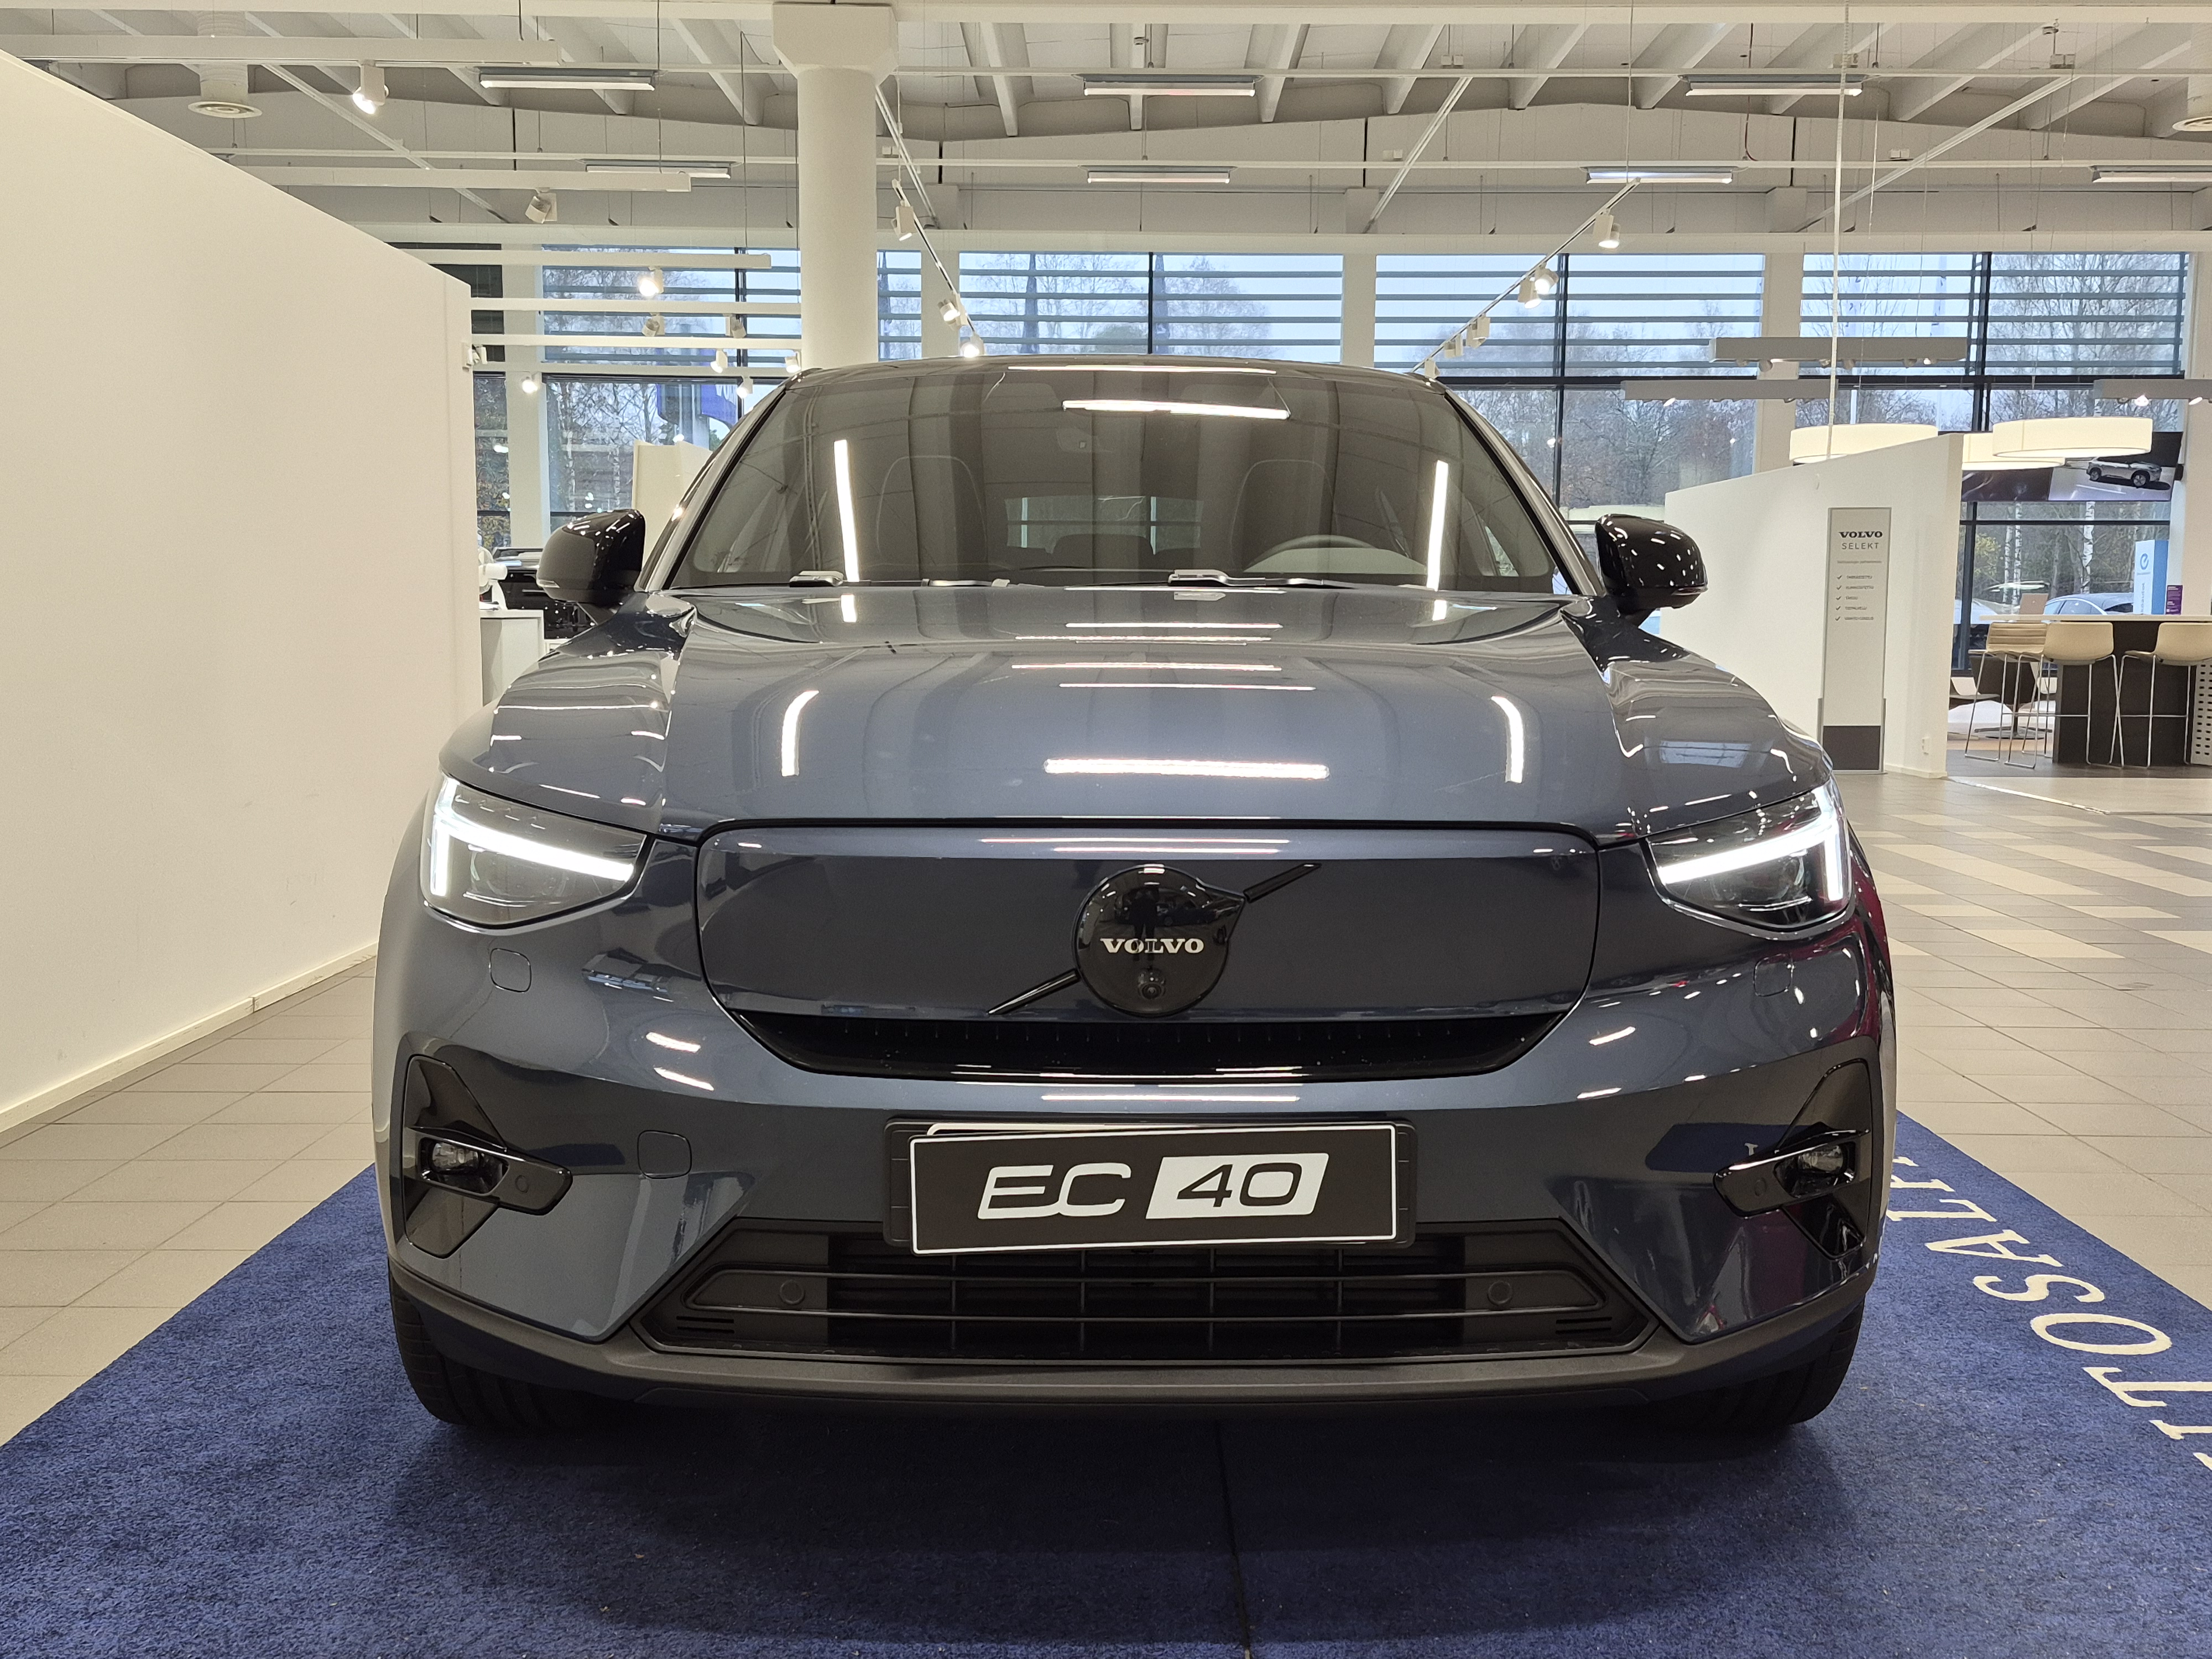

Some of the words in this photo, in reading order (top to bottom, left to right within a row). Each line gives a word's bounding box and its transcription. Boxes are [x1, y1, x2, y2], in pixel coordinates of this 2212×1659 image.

[1100, 938, 1204, 954] VOLVO
[977, 1162, 1131, 1220] EC
[1177, 1162, 1302, 1208] 40
